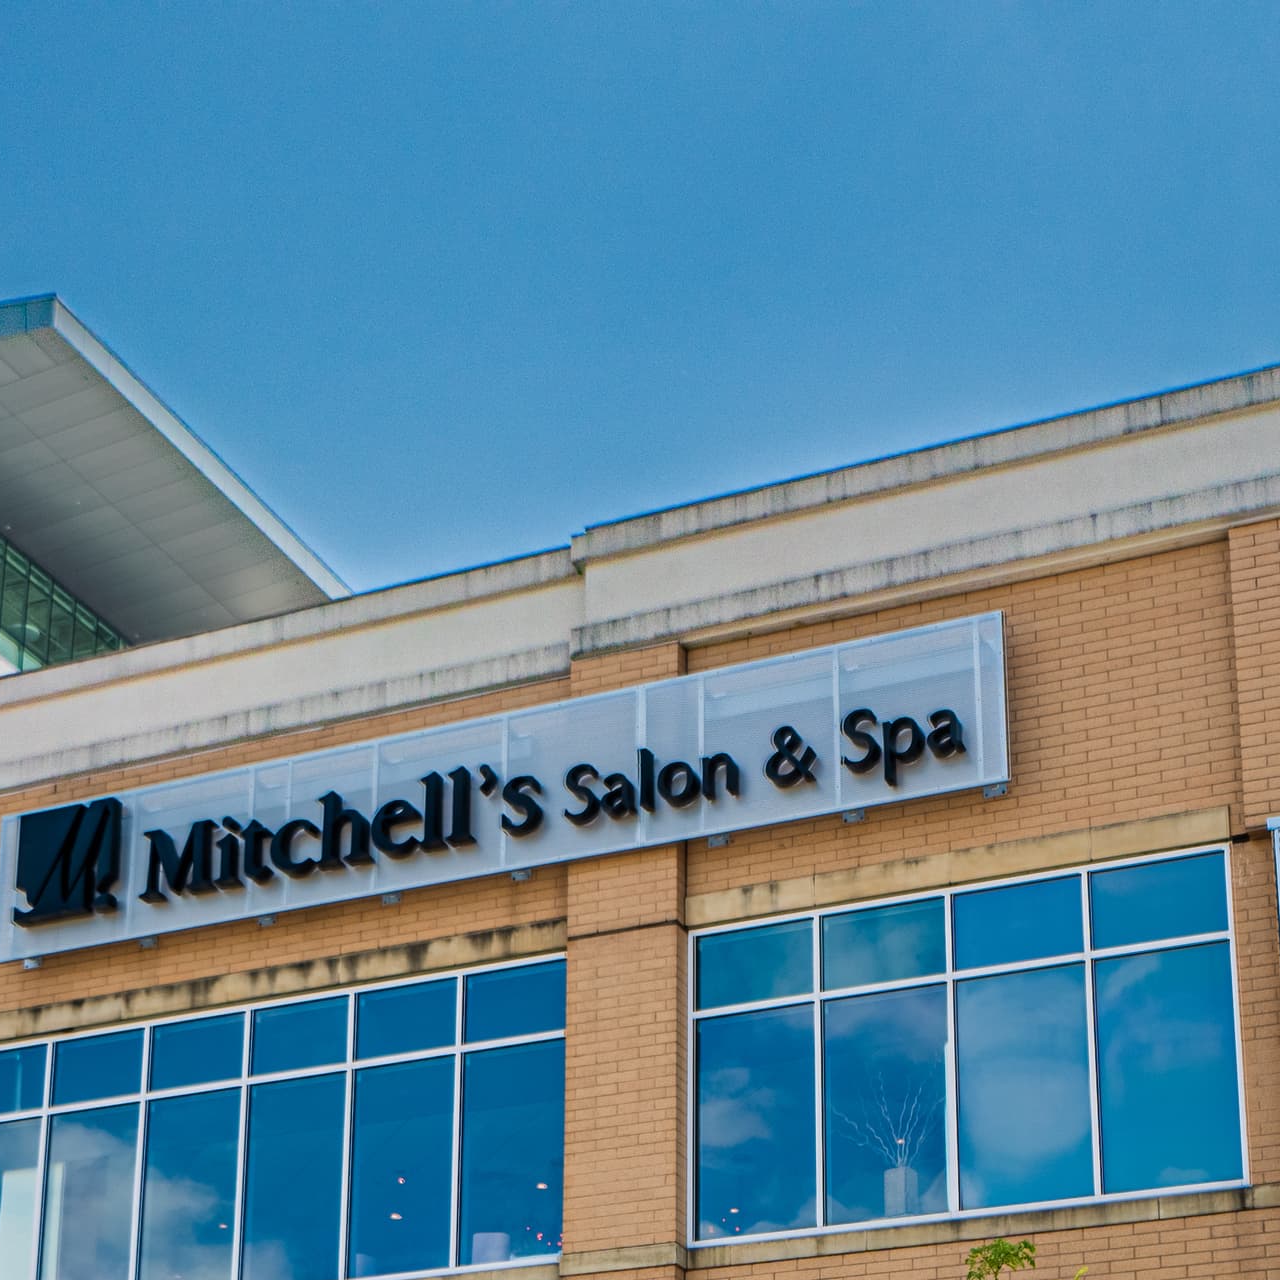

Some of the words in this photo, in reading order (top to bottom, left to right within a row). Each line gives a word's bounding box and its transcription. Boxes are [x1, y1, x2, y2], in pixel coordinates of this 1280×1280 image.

[140, 765, 543, 905] Mitchell's
[564, 747, 740, 828] Salon
[765, 725, 818, 789] &
[839, 708, 966, 787] Spa
